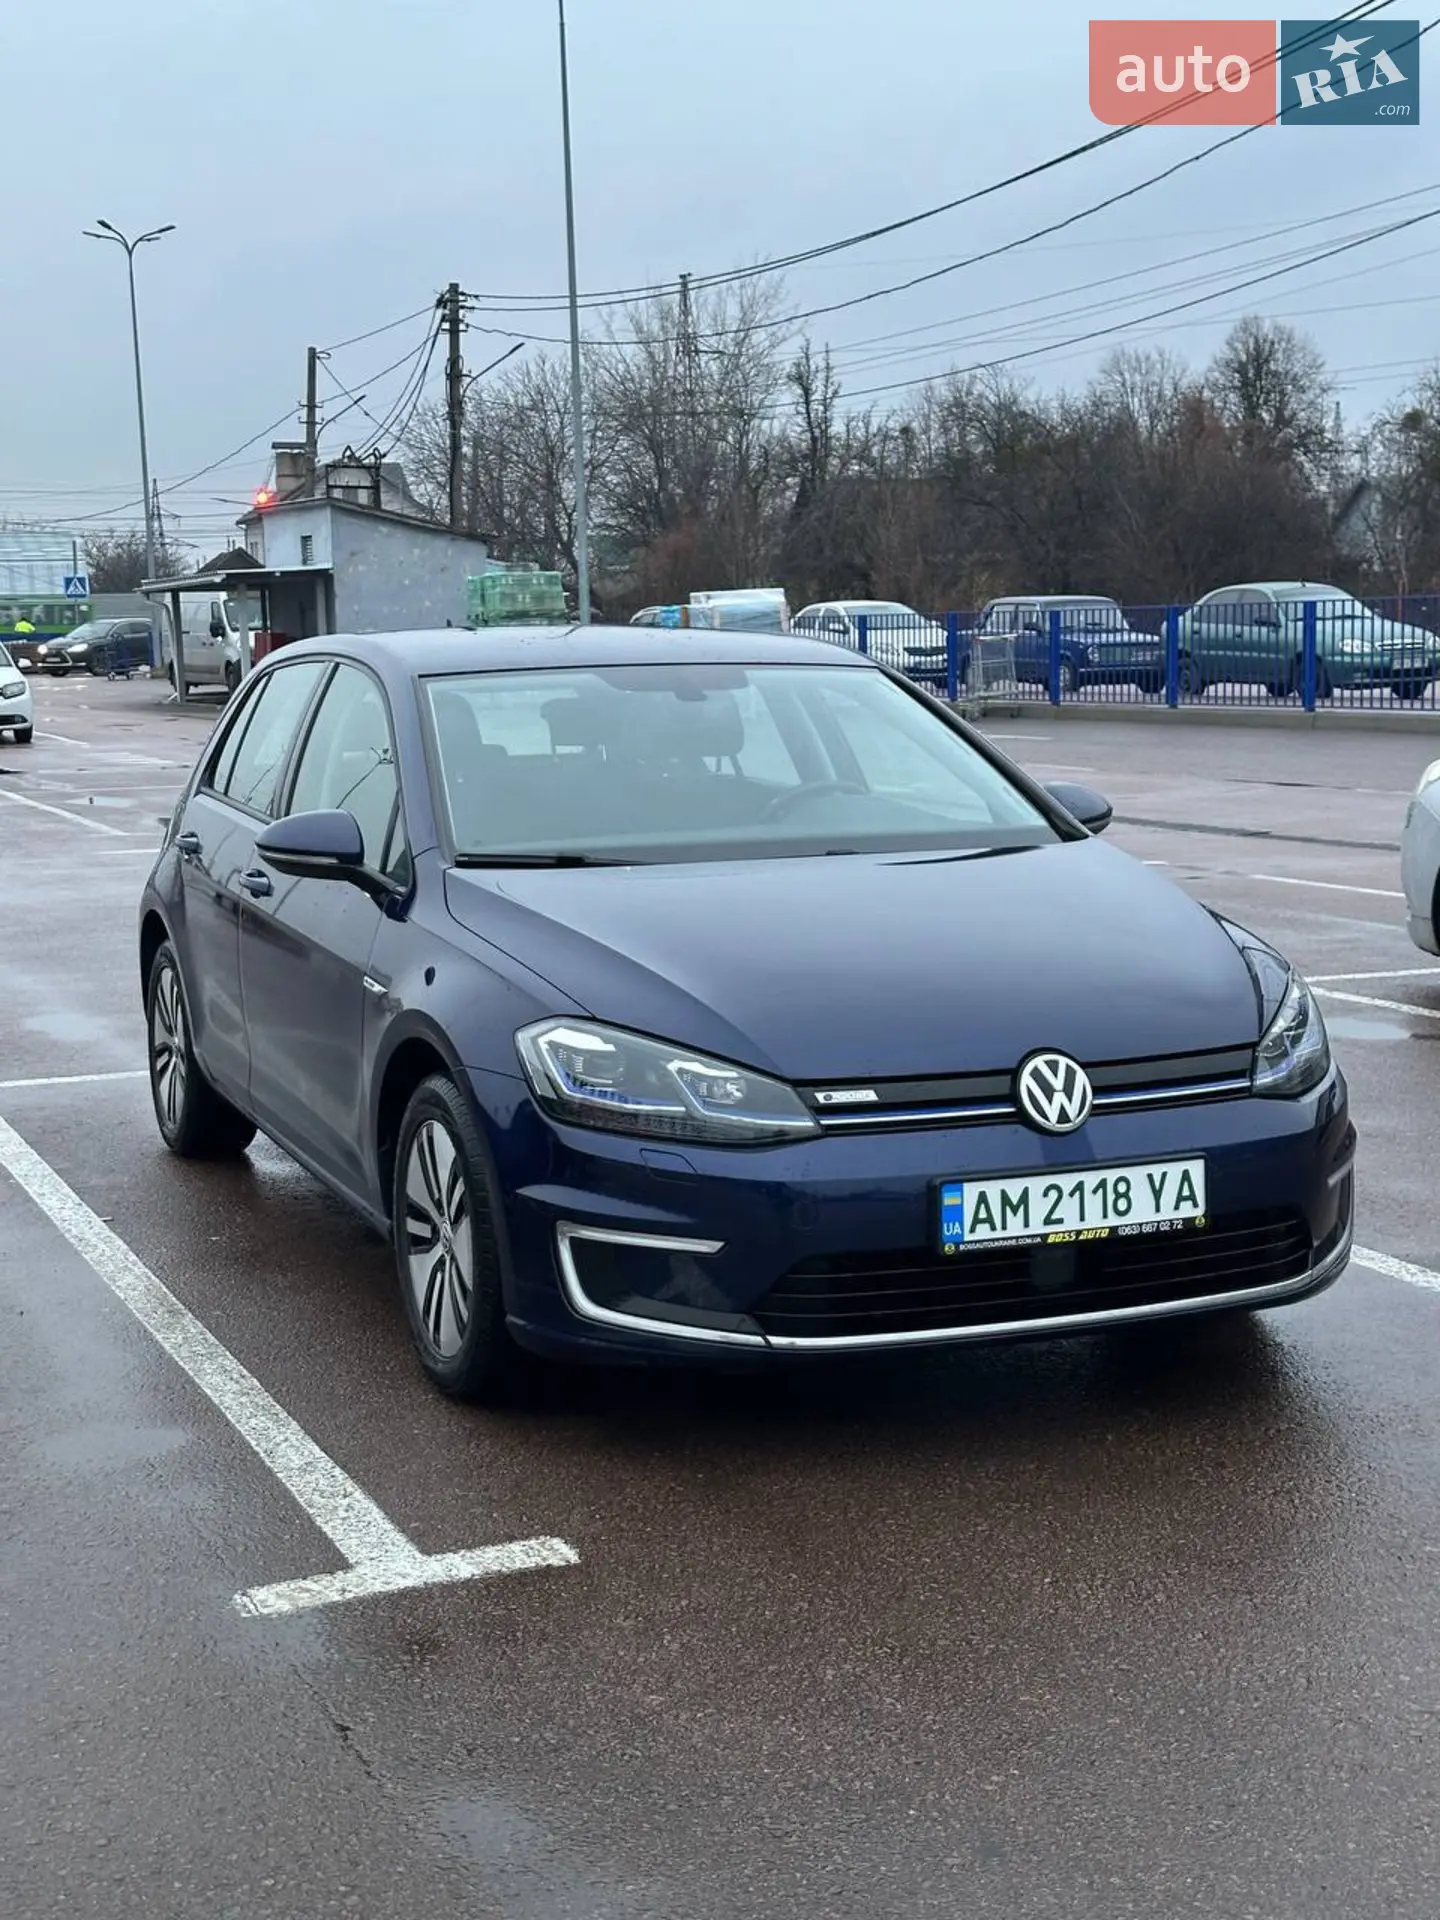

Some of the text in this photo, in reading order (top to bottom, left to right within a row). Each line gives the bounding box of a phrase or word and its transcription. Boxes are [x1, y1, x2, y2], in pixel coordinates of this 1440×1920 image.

[968, 1168, 1200, 1234] AM 2118 YA
[943, 1222, 962, 1236] UA
[1046, 1227, 1111, 1244] BOSS AUTO
[1117, 1224, 1141, 1237] (063)
[1173, 1219, 1184, 1230] 72
